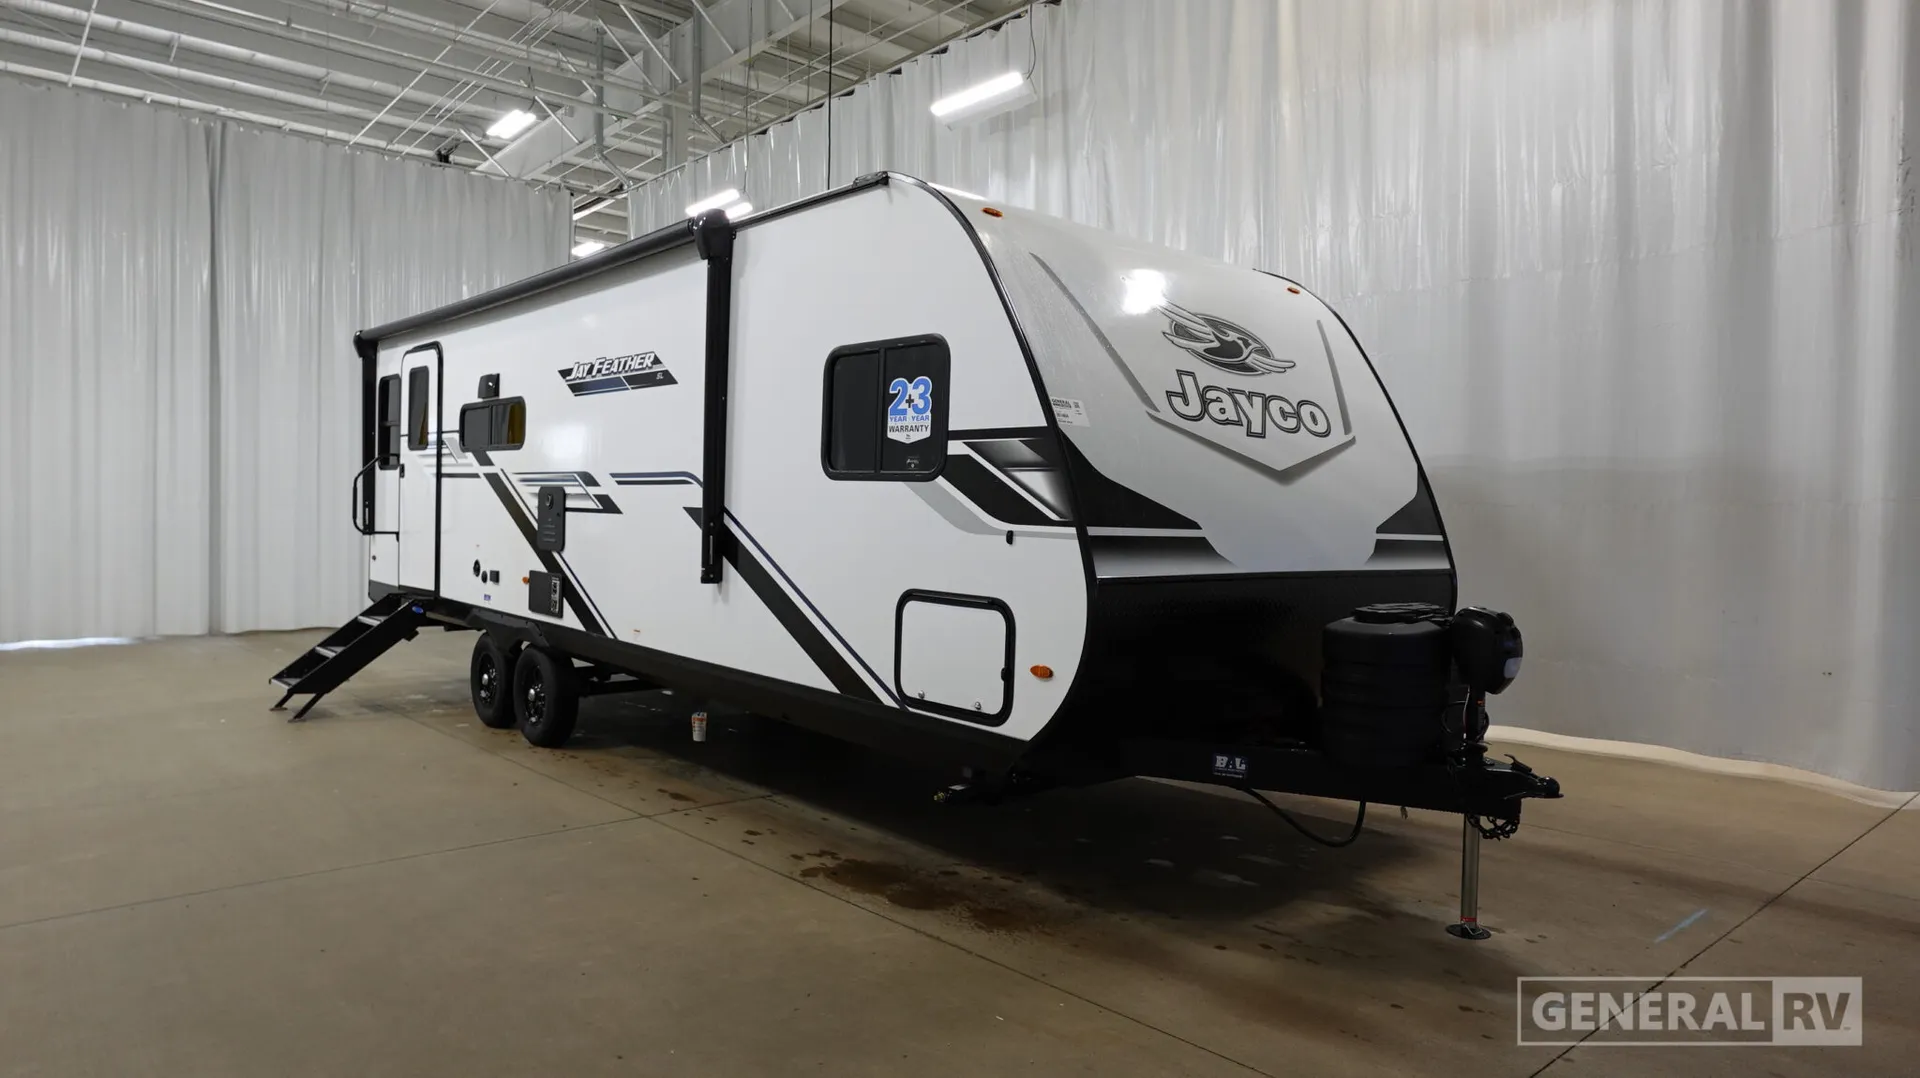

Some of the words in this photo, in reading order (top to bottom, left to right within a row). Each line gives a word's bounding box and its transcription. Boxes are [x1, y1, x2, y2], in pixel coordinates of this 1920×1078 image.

[565, 362, 592, 382] JAY
[592, 351, 655, 376] FEATHER
[1165, 369, 1332, 439] Jayco
[911, 414, 930, 422] YEAR
[888, 424, 930, 433] WARRANTY
